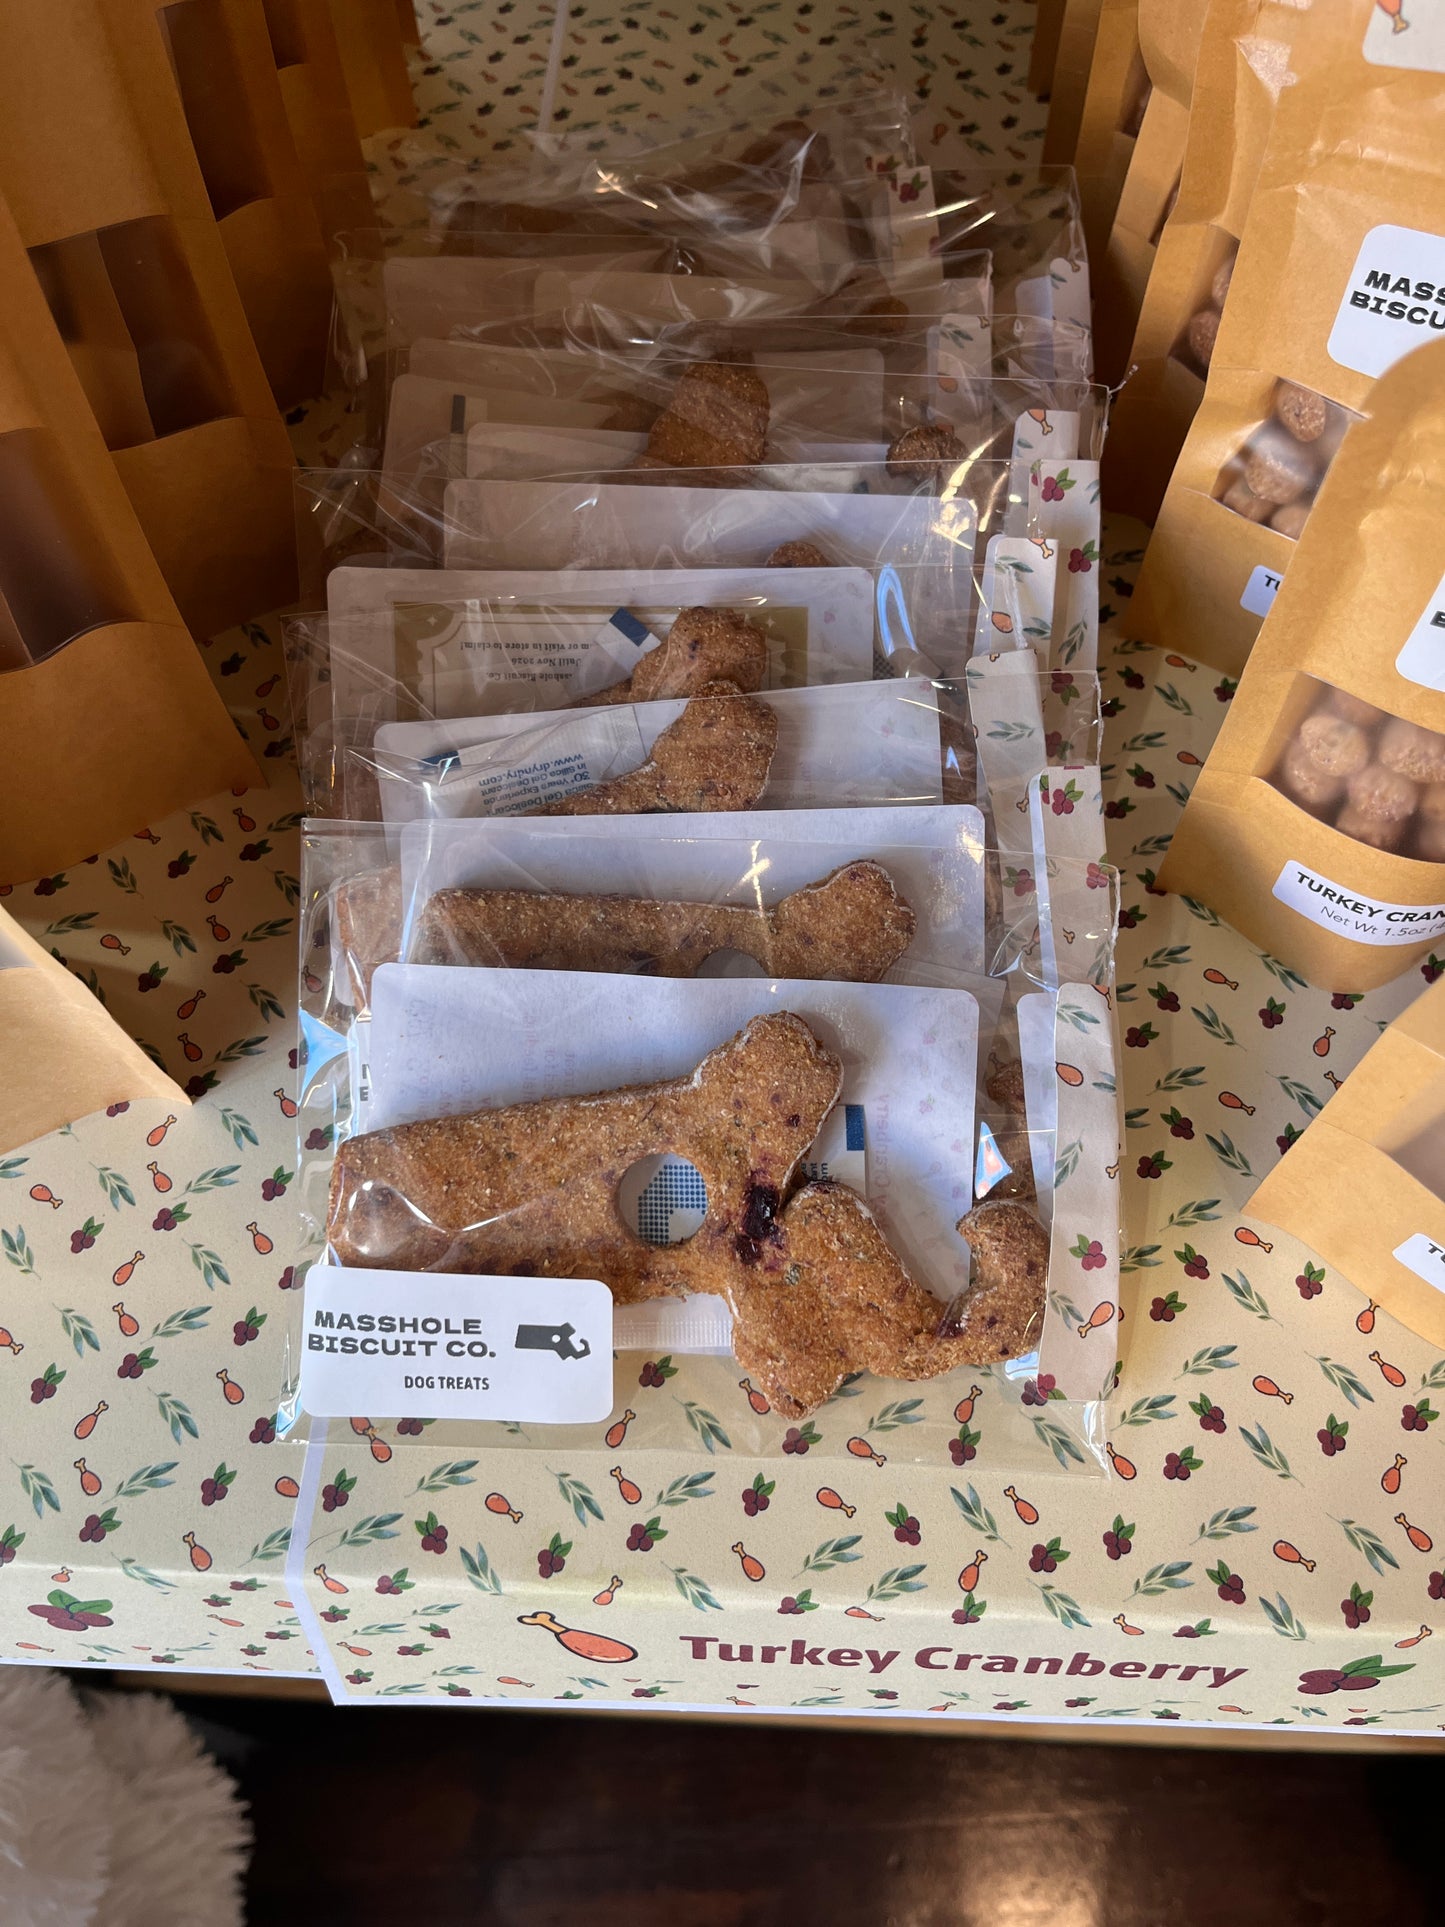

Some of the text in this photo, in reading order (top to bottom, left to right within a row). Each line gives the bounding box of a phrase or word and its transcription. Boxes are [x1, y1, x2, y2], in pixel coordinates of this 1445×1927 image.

[537, 658, 556, 666] Nov
[478, 754, 584, 787] www.dryndry.com
[550, 765, 576, 777] Silica
[1297, 871, 1384, 918] TURKEY
[1320, 905, 1350, 926] Net
[1355, 920, 1378, 935] Wt
[1384, 926, 1426, 937] 1.5oz
[314, 1309, 482, 1335] MASSHOLE
[307, 1333, 497, 1359] BISCUIT CO.
[404, 1375, 490, 1391] DOG TREATS
[679, 1635, 1249, 1689] Turkey Cranberry
